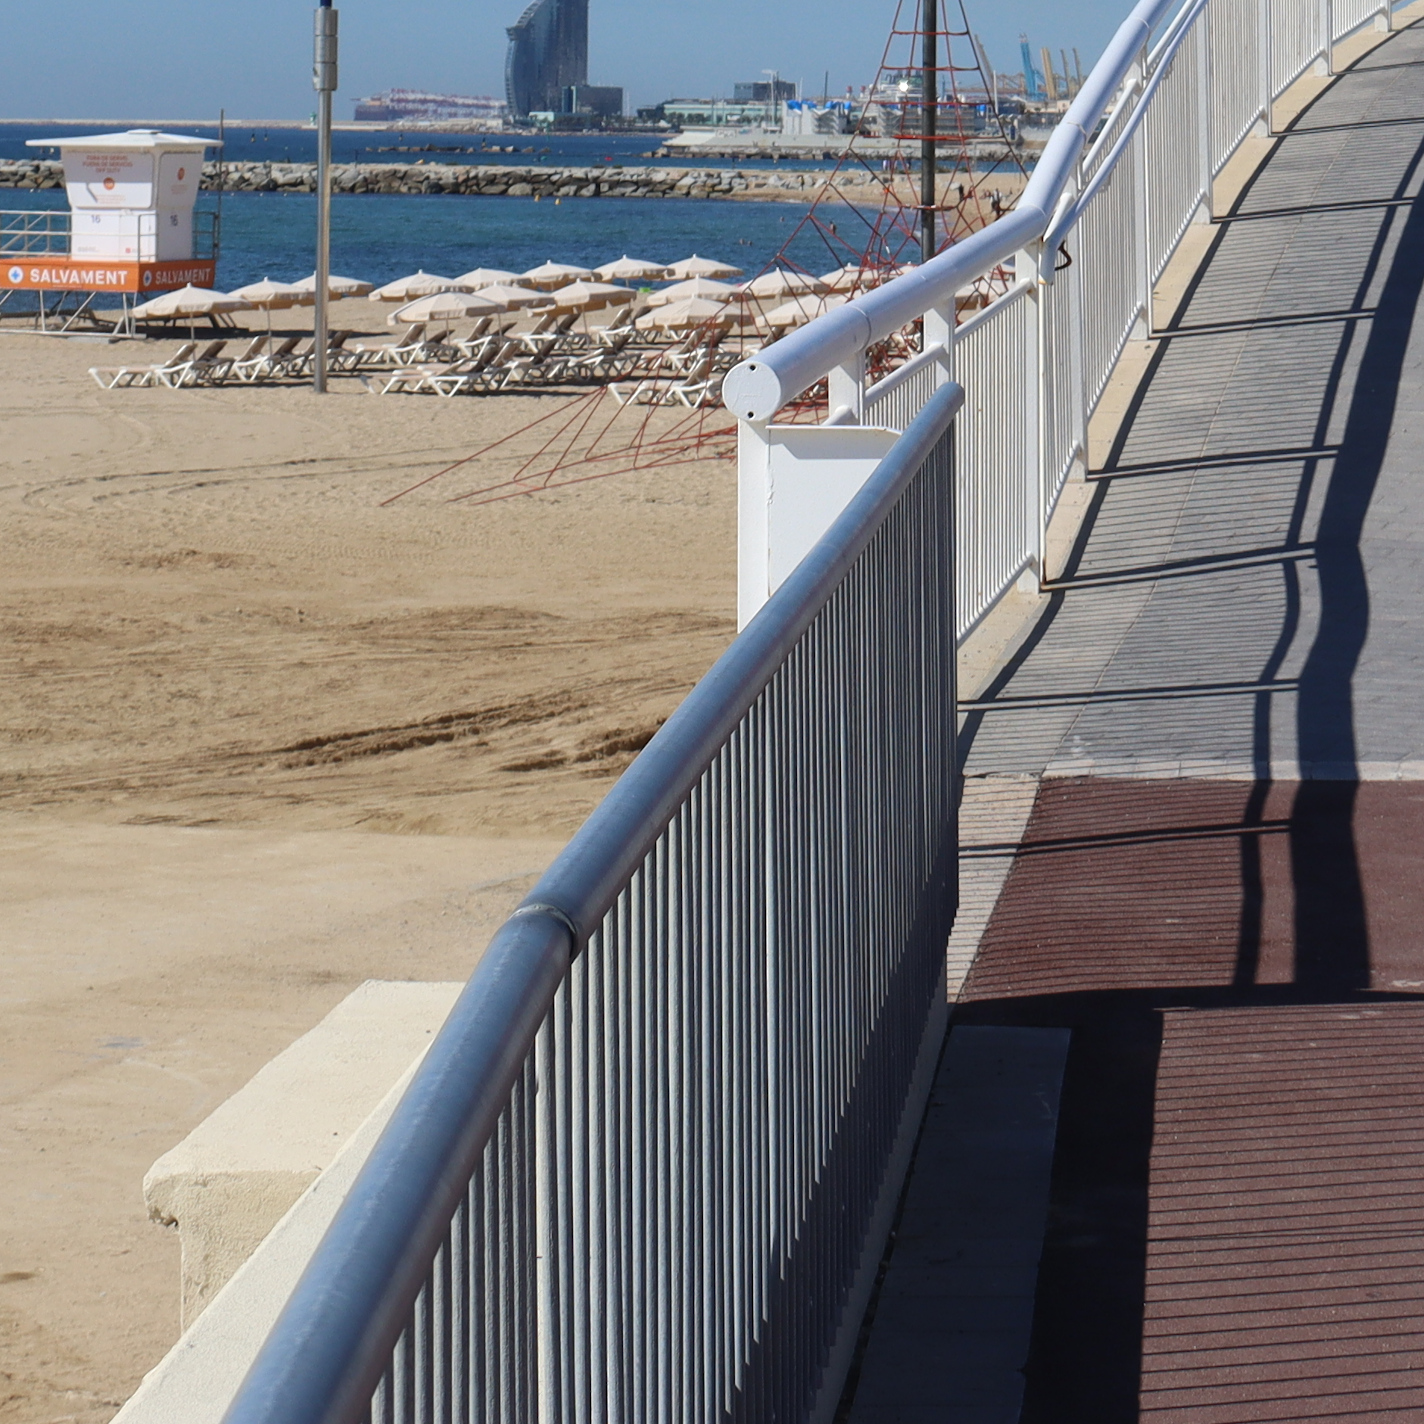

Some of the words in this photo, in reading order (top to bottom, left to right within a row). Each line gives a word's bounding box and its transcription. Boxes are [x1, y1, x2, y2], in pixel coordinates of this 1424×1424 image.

[91, 214, 101, 224] 16
[30, 268, 128, 285] SALVAMENT
[155, 268, 211, 285] SALVAMENT
